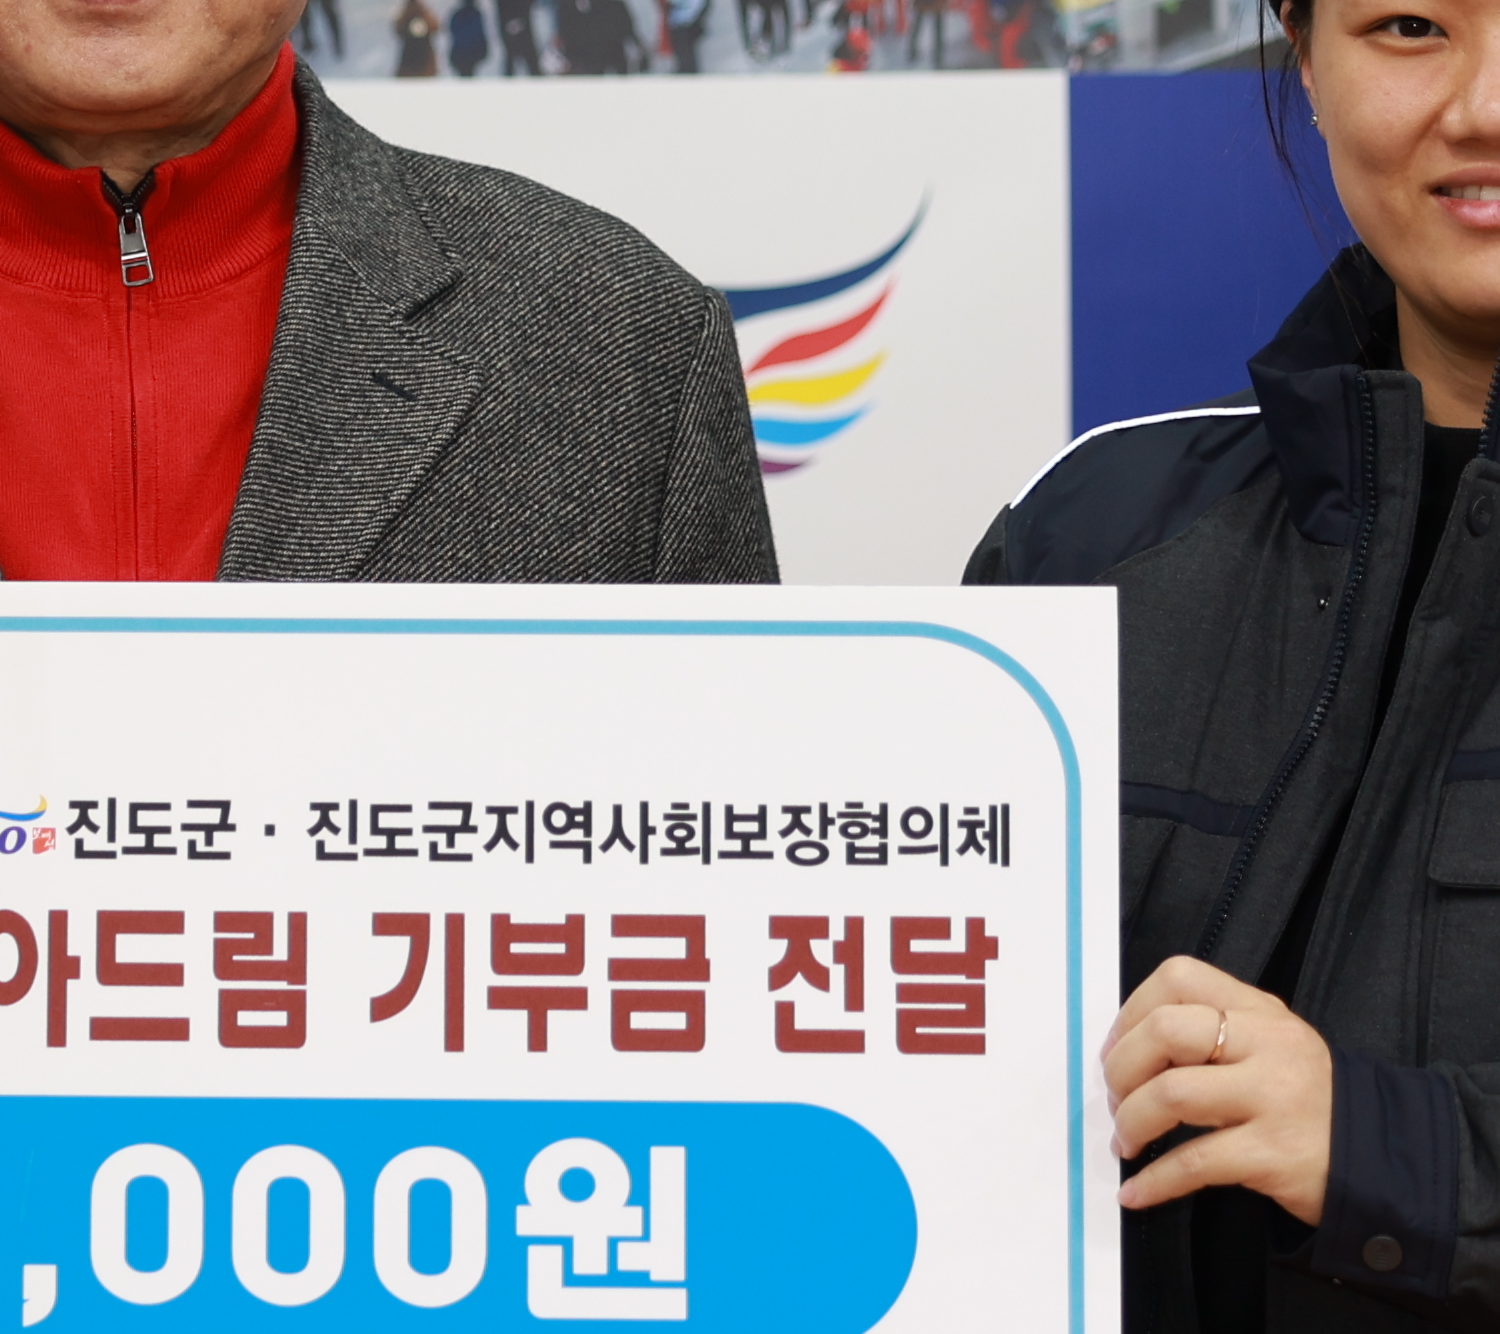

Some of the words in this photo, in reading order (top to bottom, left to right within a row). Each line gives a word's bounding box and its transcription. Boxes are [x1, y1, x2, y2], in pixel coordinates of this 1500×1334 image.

[65, 797, 237, 860] 진도군
[306, 799, 1010, 867] 진도군지역사회보장협의체
[372, 913, 710, 1052] 기부금
[770, 916, 998, 1055] 전달
